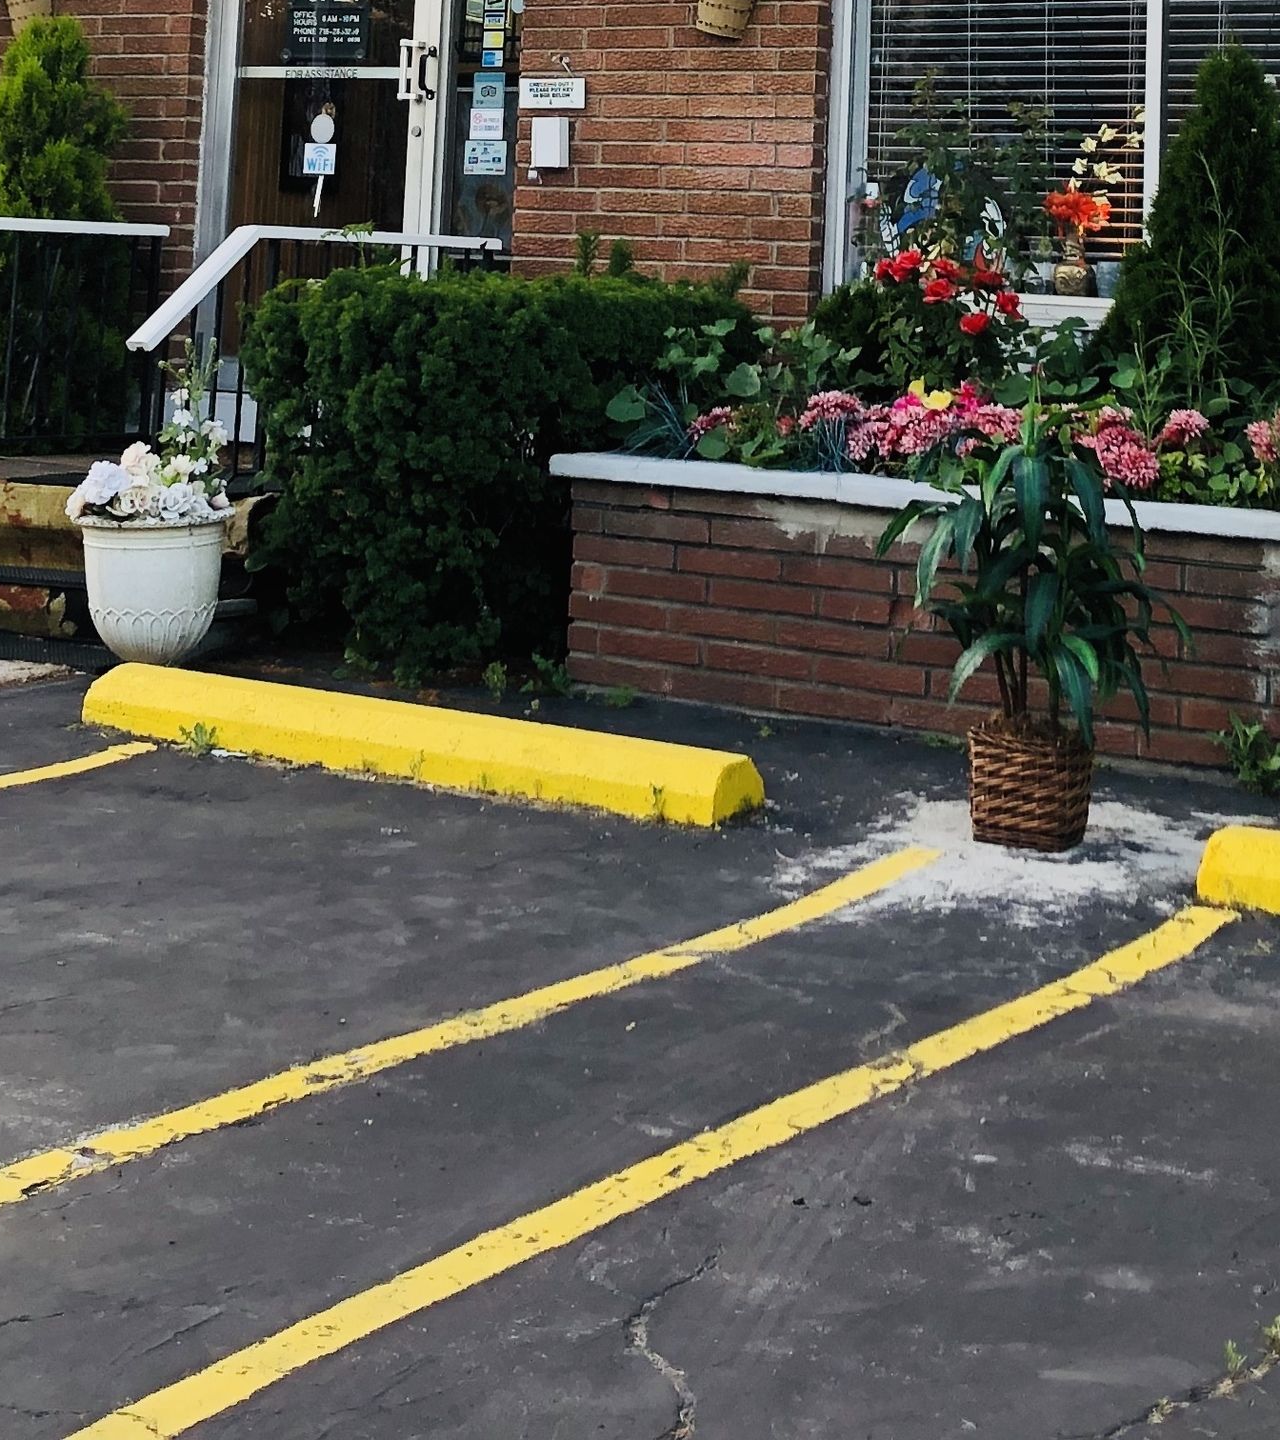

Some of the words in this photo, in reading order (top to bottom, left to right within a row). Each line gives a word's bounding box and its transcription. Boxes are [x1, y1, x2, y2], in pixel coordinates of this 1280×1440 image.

[293, 11, 317, 19] OFFICE
[293, 27, 317, 35] PHONE
[307, 158, 333, 171] WiFi
